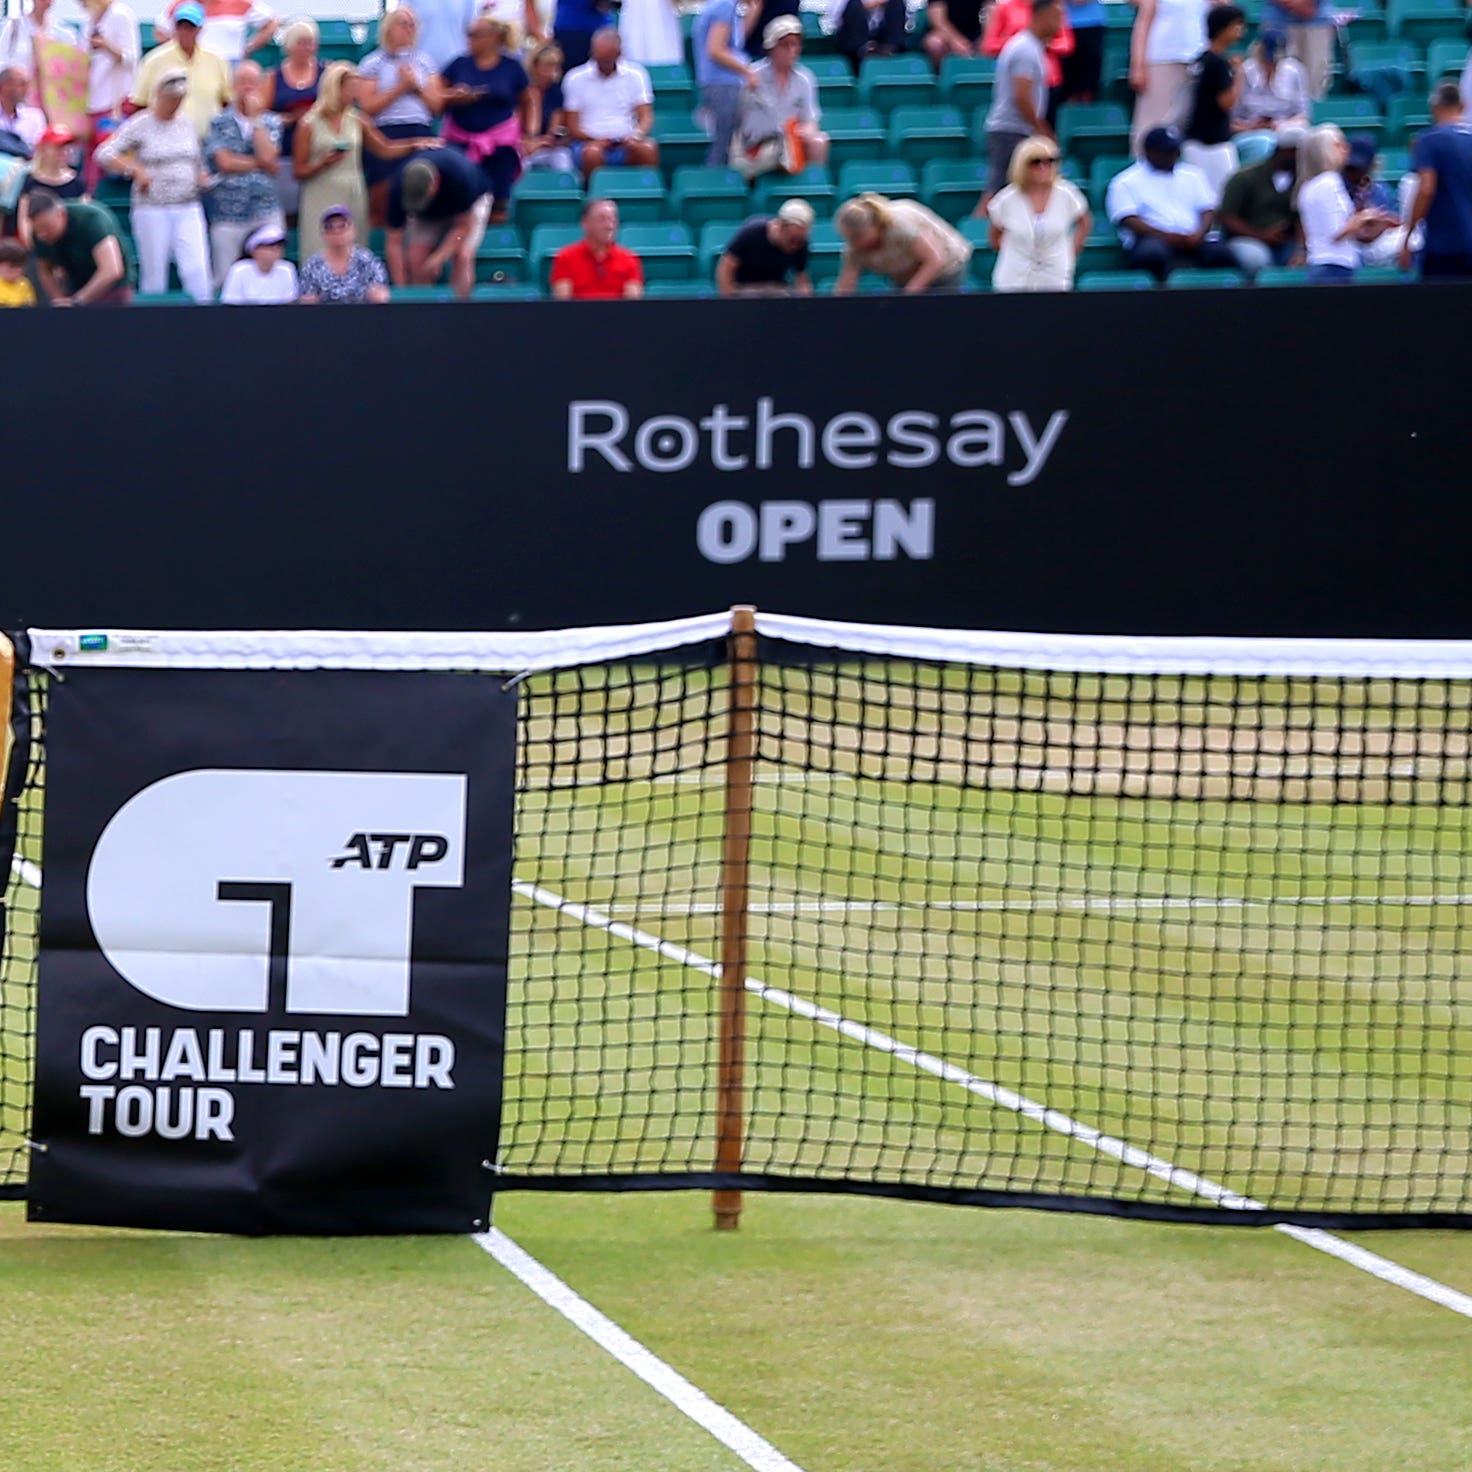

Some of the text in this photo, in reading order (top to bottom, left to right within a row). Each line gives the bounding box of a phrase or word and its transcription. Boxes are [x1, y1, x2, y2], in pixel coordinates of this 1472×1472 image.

[567, 397, 1070, 486] Rothesay
[696, 498, 936, 564] OPEN
[330, 833, 448, 870] ATP
[79, 1025, 455, 1089] CHALLENGER
[79, 1086, 235, 1142] TOUR
